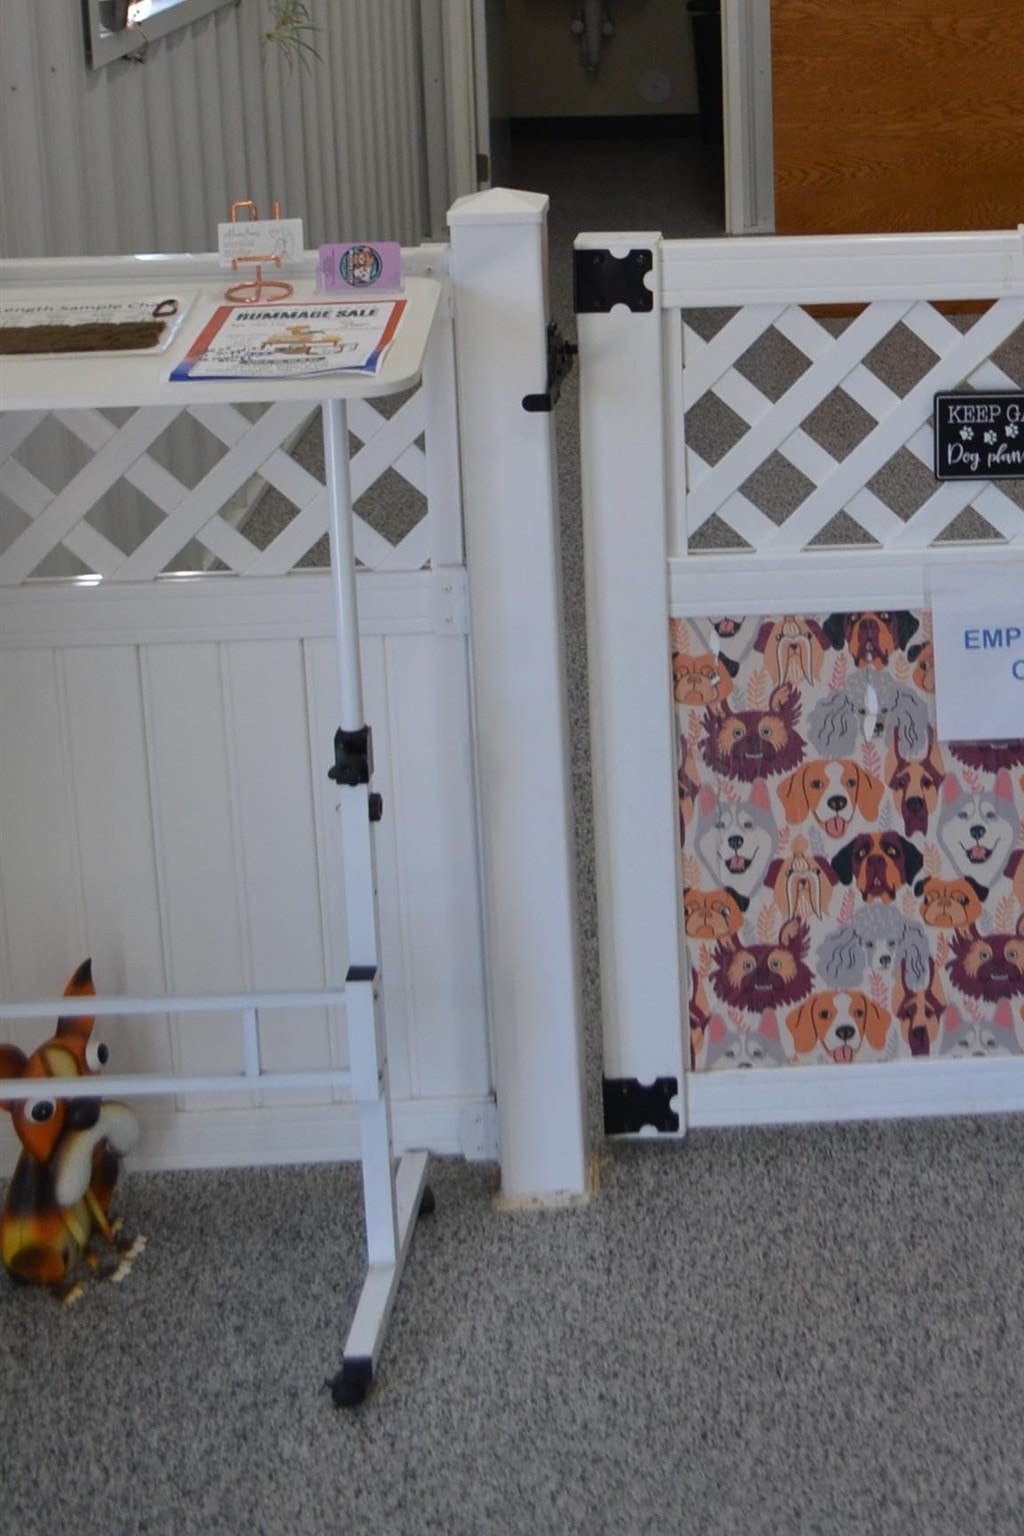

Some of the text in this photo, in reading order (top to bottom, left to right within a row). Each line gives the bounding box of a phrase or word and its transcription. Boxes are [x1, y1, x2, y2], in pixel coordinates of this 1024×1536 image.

[2, 305, 54, 313] ength
[236, 308, 380, 321] RUMMAGE SALE
[948, 405, 1001, 424] KEEP
[947, 442, 981, 471] Dog
